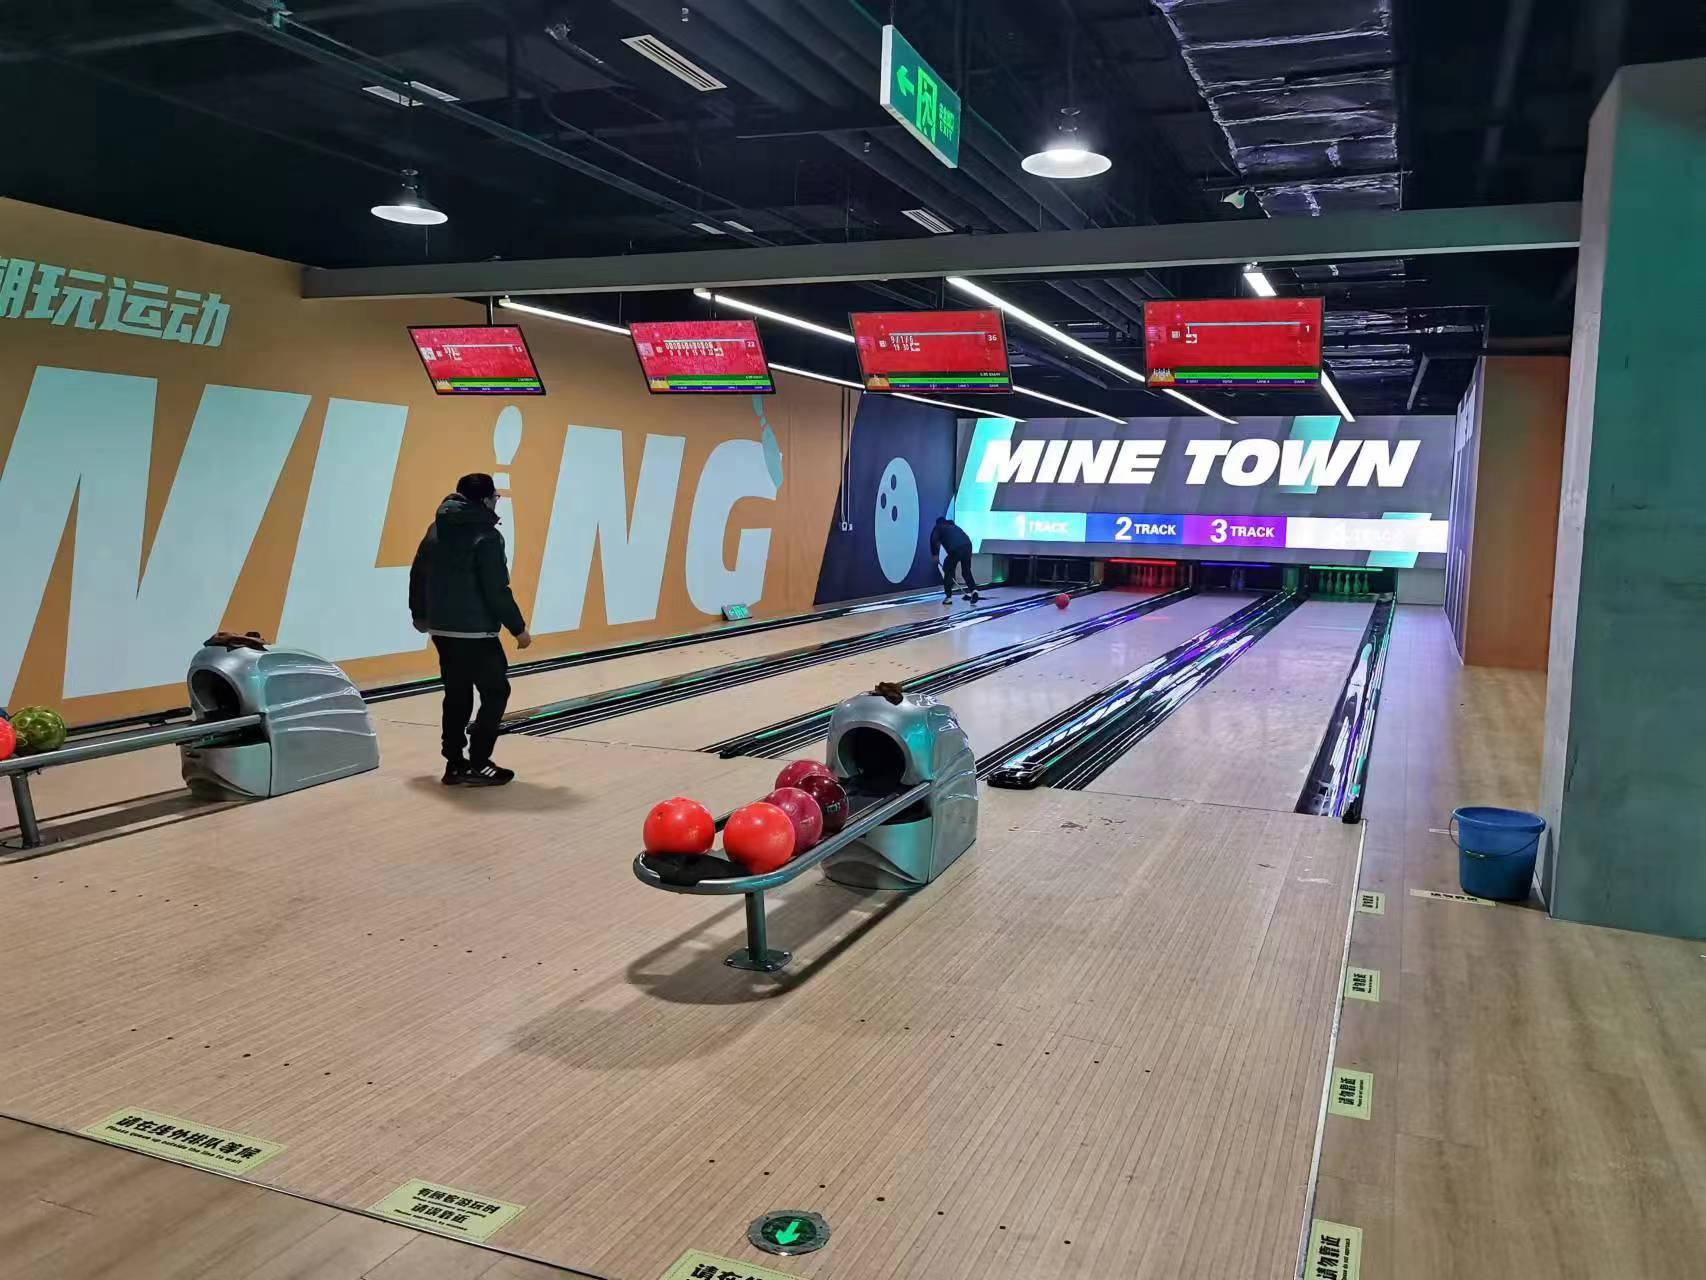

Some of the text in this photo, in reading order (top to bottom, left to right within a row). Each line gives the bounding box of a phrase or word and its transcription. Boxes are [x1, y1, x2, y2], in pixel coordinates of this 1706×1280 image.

[976, 439, 1421, 487] MINE TOWN
[1114, 516, 1177, 541] 2 TRACK
[1210, 518, 1276, 544] 3 TRACK
[115, 1115, 262, 1159] 请在线外排队等候
[691, 1263, 763, 1280] 请在
[1316, 1234, 1341, 1280] 请勿靠近
